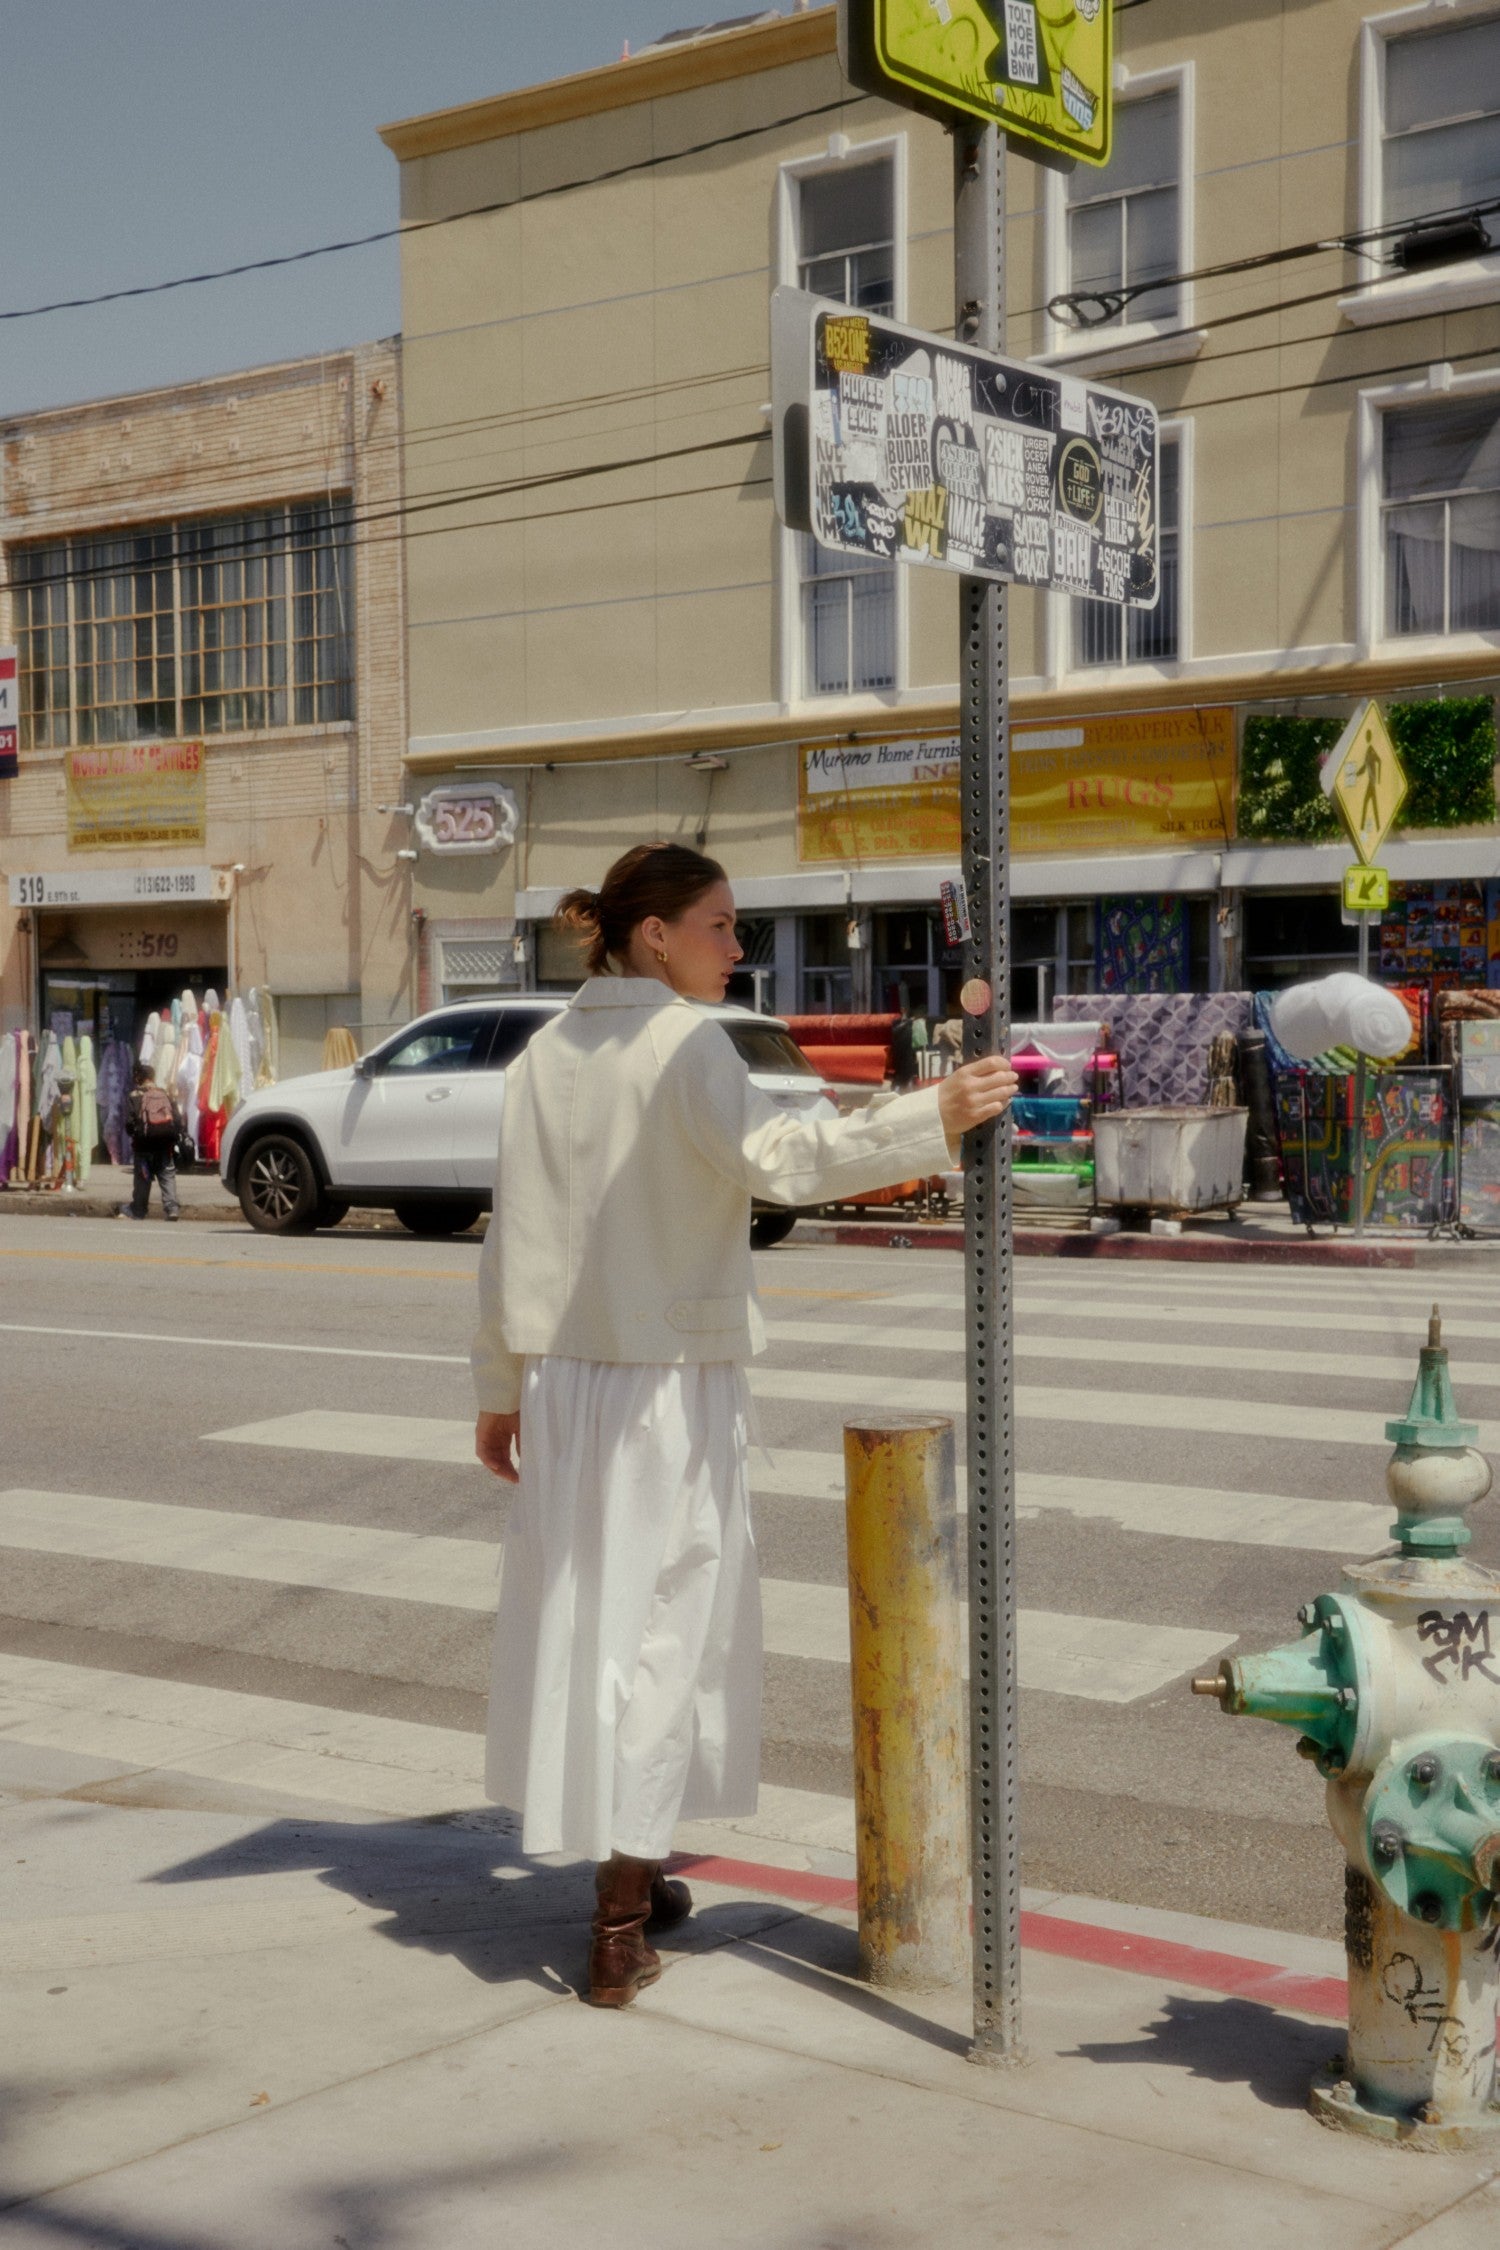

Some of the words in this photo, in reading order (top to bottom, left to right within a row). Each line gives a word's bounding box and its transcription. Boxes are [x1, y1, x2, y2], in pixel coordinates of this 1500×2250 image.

[1008, 4, 1031, 24] TOLT
[1009, 22, 1032, 43] HOE
[1011, 41, 1033, 60] J4F
[1011, 60, 1035, 80] BNW
[888, 438, 929, 466] BUDAR
[1024, 438, 1048, 451] URGER
[890, 463, 931, 491] SEYMR
[1027, 462, 1047, 474] ANEK
[1025, 485, 1050, 498] VENEK
[1026, 497, 1050, 513] OFAK
[1103, 570, 1126, 601] FMS
[71, 751, 109, 778] WORLD
[804, 748, 872, 776] Murano
[877, 745, 913, 764] Home
[1066, 772, 1175, 810] RUGS
[436, 800, 495, 841] 525
[1159, 821, 1186, 833] SILK
[1192, 818, 1226, 831] RUGS
[19, 876, 44, 903] 519
[141, 932, 179, 957] 519
